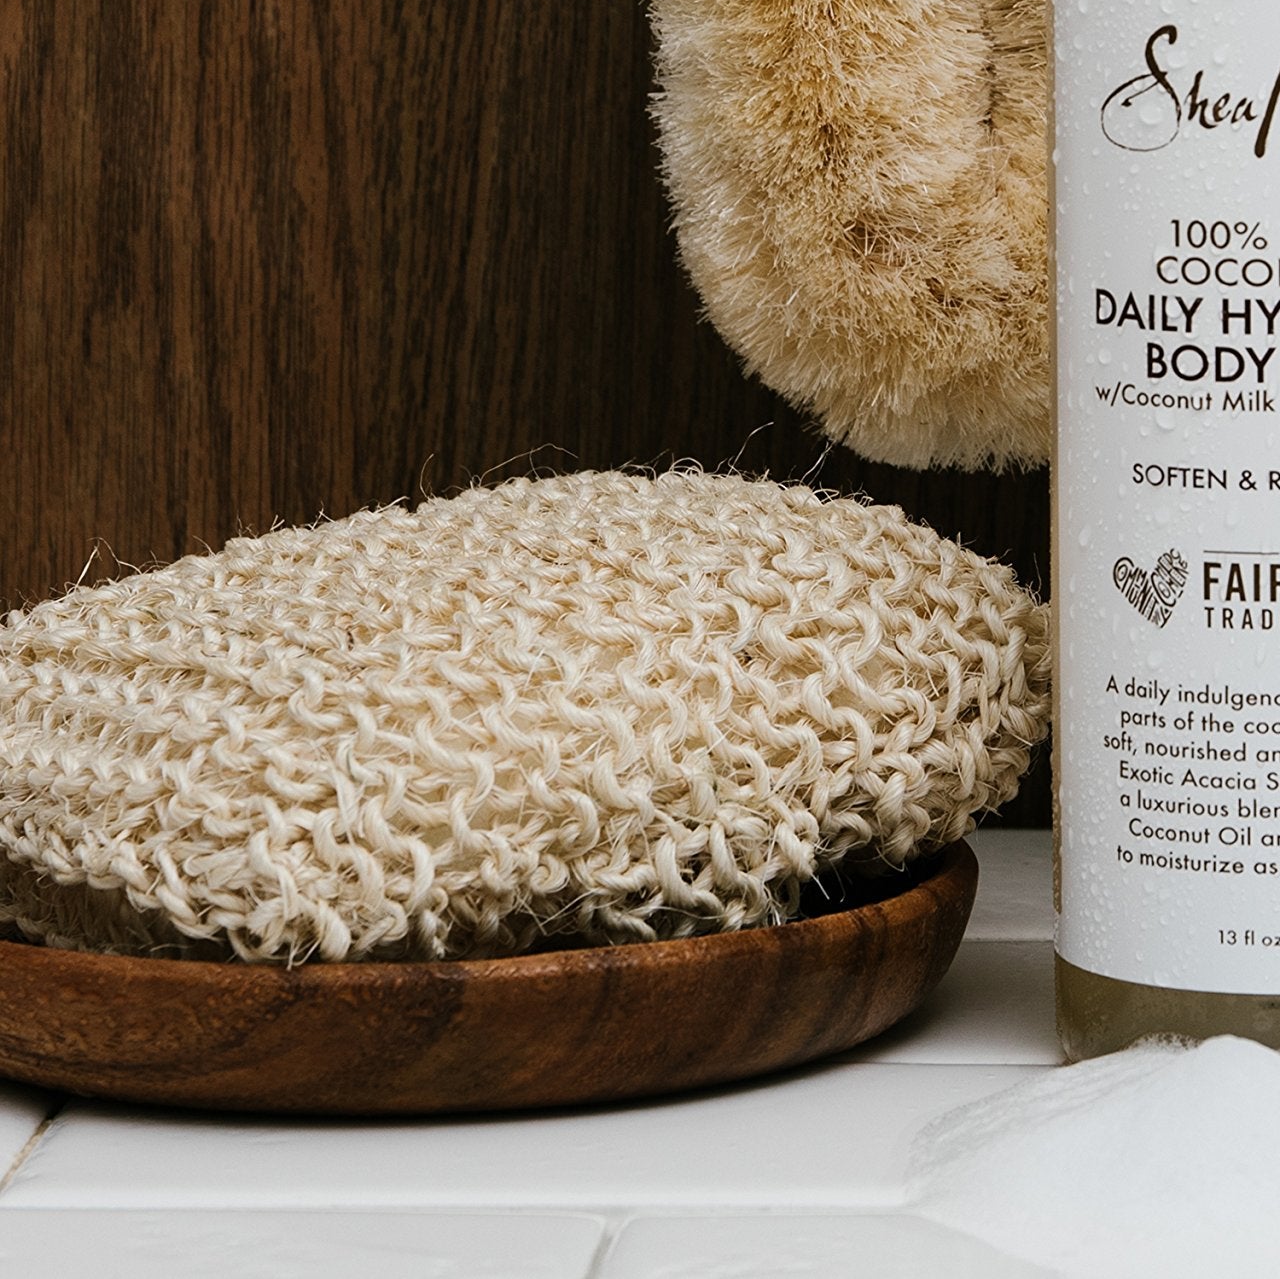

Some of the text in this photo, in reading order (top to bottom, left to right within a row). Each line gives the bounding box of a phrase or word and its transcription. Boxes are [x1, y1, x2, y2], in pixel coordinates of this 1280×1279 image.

[1170, 219, 1268, 251] 100%
[1095, 287, 1204, 334] DAILY
[1146, 341, 1277, 384] BODY
[1095, 381, 1213, 412] w/Coconut
[1222, 389, 1276, 412] Milk
[1132, 462, 1228, 490] SOFTEN
[1238, 469, 1258, 491] &
[1105, 674, 1120, 694] A
[1124, 676, 1171, 707] daily
[1120, 710, 1167, 729] parts
[1173, 710, 1195, 731] of
[1201, 712, 1235, 734] the
[1103, 730, 1137, 755] soft,
[1144, 740, 1247, 762] nourished
[1119, 759, 1174, 786] Exotic
[1180, 768, 1257, 791] Acacia
[1119, 793, 1131, 808] a
[1137, 789, 1229, 818] luxurious
[1128, 817, 1211, 844] Coconut
[1218, 826, 1251, 847] Oil
[1116, 844, 1134, 864] to
[1139, 851, 1245, 874] moisturize
[1253, 861, 1279, 875] as
[1218, 929, 1237, 946] 13
[1244, 929, 1255, 946] fl
